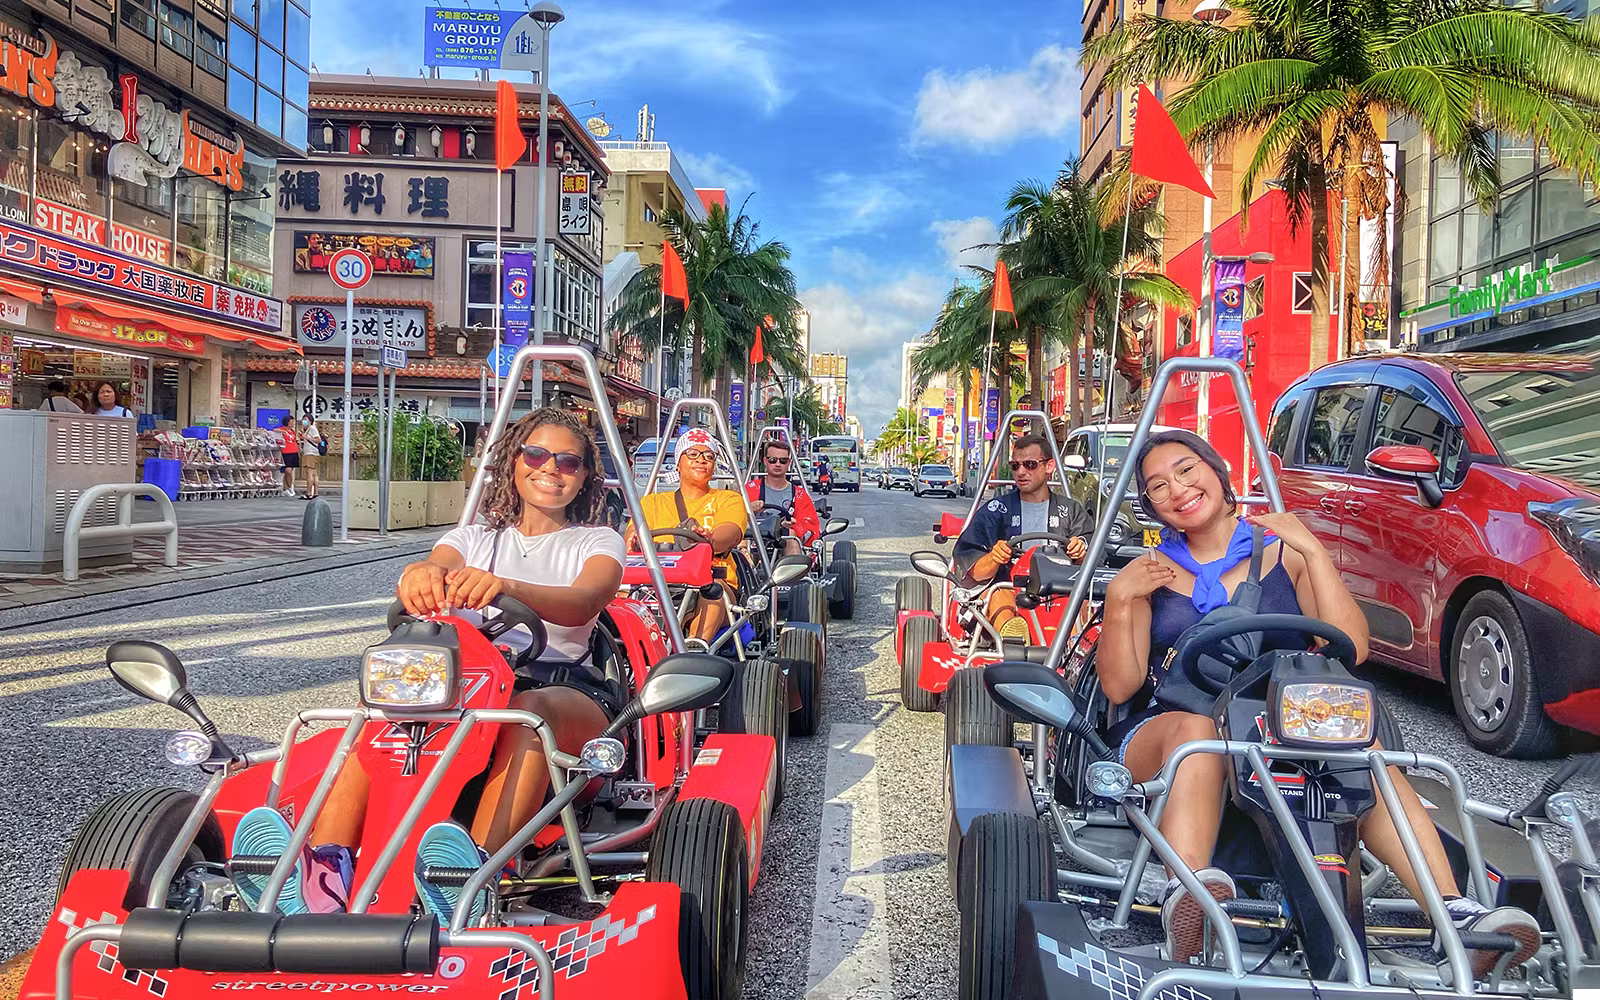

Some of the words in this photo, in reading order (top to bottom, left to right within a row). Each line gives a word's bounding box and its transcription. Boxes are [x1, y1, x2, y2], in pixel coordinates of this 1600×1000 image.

[433, 22, 501, 35] MARUYU
[444, 35, 501, 46] GROUP
[563, 176, 587, 192] 無料
[279, 169, 450, 217] 縄料理
[5, 205, 26, 222] LOIN
[561, 214, 588, 229] ライブ
[36, 202, 99, 243] STEAK
[111, 226, 166, 263] HOUSE
[0, 231, 117, 280] クドラッグ
[339, 260, 363, 278] 30
[1449, 258, 1551, 318] FamilyMart
[211, 979, 449, 993] streetpower
